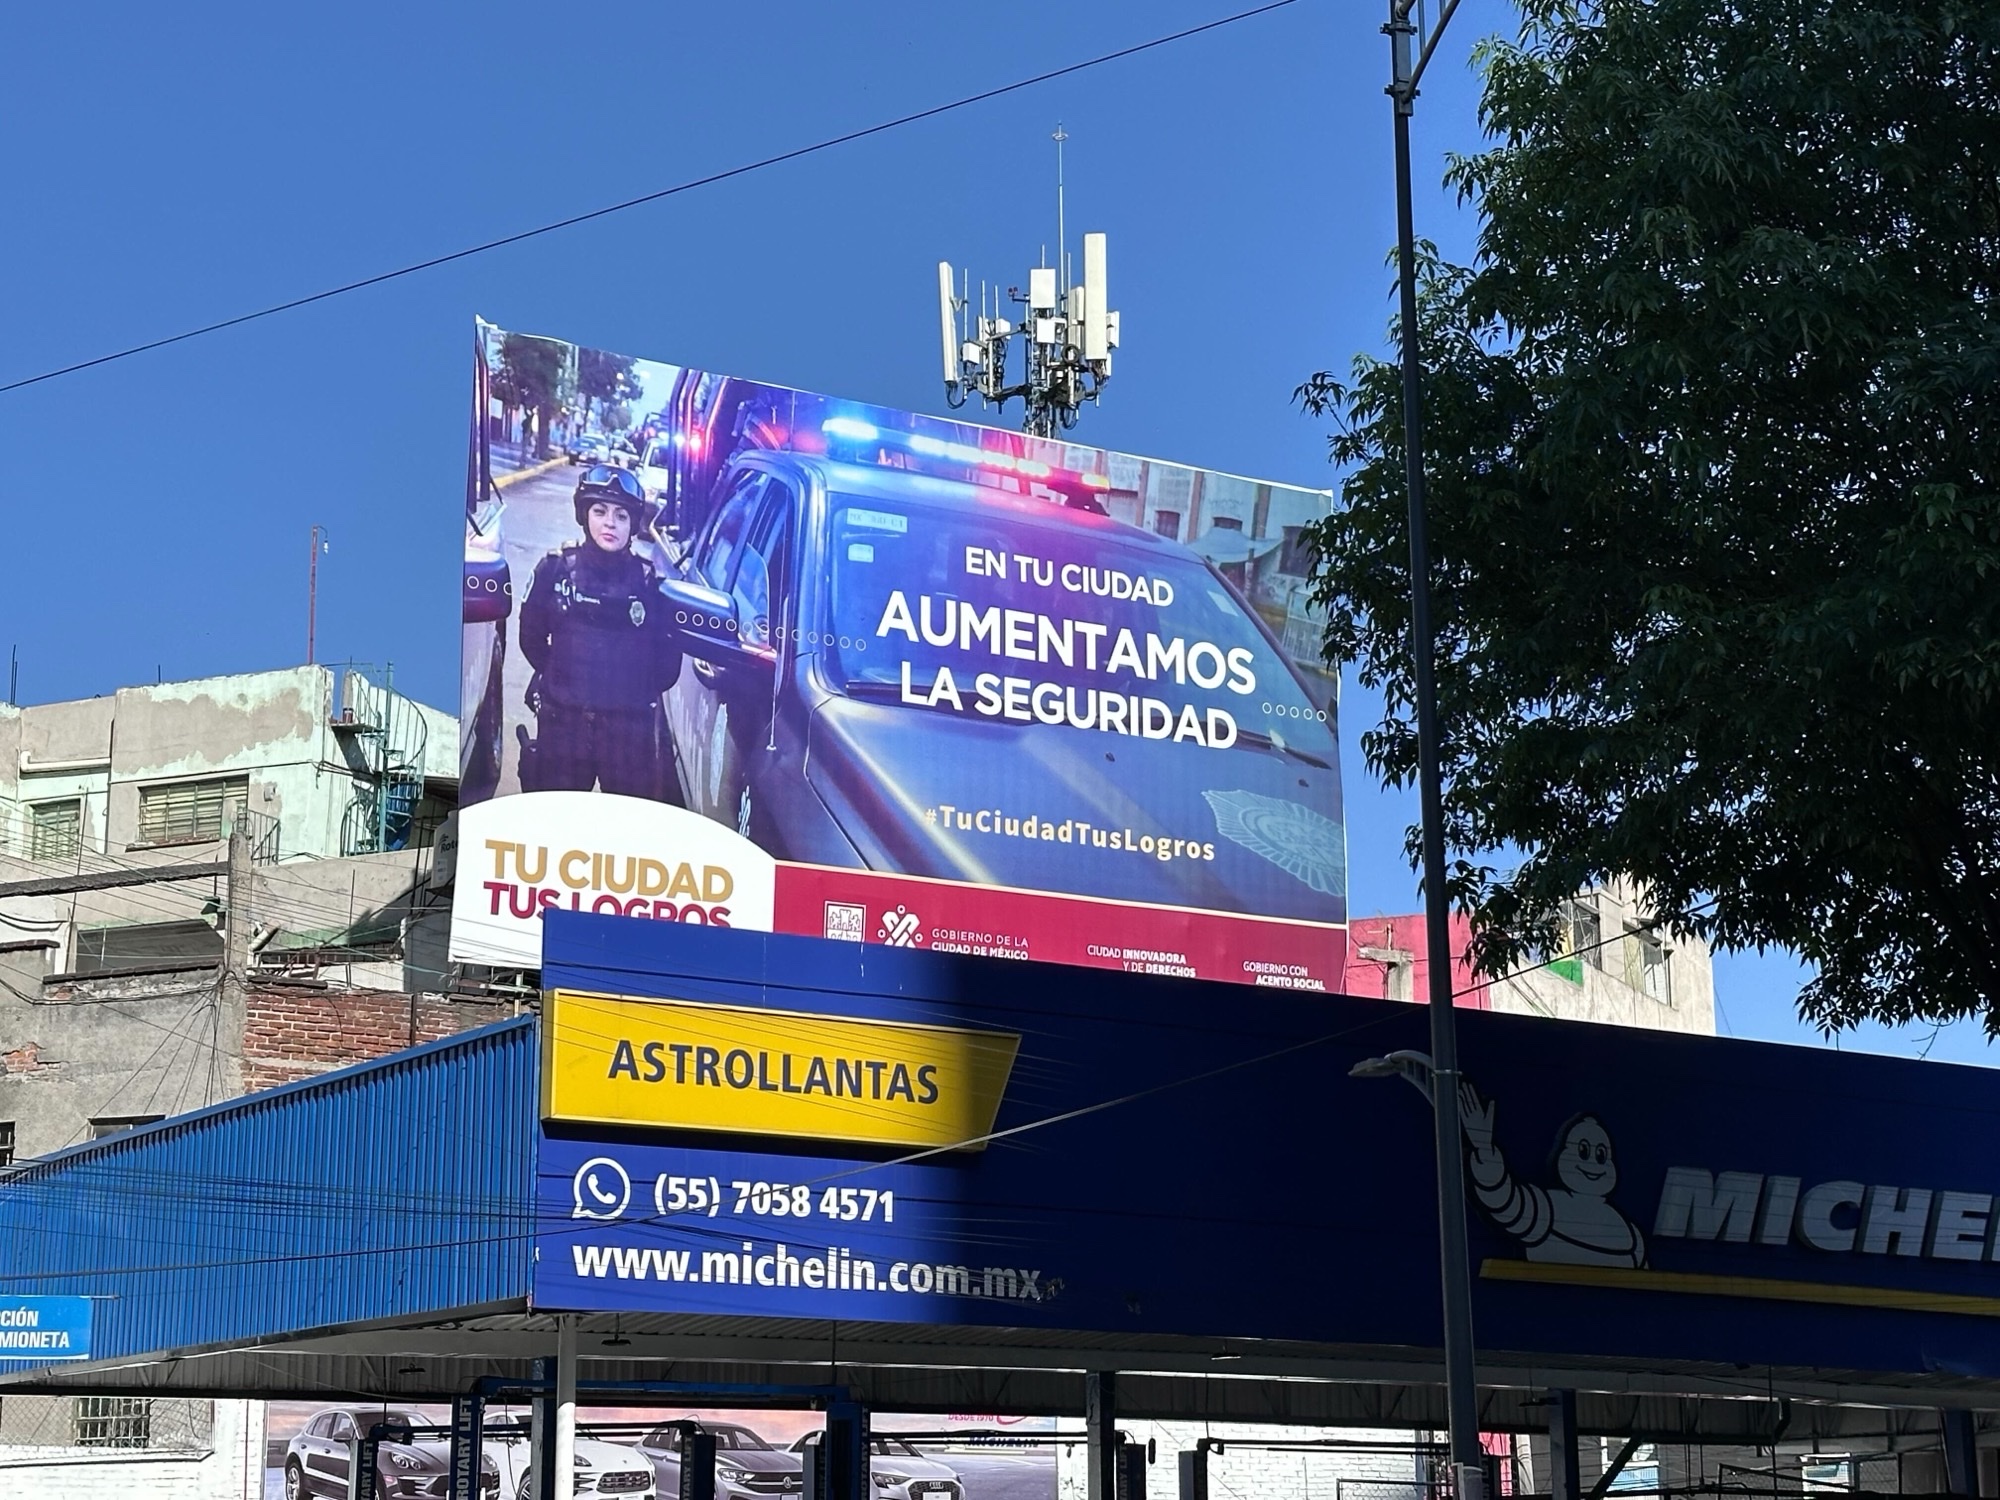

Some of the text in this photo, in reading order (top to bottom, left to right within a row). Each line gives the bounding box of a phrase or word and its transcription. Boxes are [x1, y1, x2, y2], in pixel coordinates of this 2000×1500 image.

[965, 546, 1175, 607] EN TU CIUDAD
[875, 590, 1257, 695] AUMENTAMOS
[901, 661, 1238, 750] LA SEGURIDAD
[924, 805, 1216, 862] #TuCiudadTusLogros
[485, 839, 549, 884] TU
[558, 850, 734, 903] CIUDAD
[483, 881, 561, 921] TUS
[931, 928, 1029, 948] GOBIERNO DE LA
[931, 941, 1029, 960] CIUDAD DE MÉXICO
[1086, 945, 1187, 965] CIUDAD INNOVADORA
[1123, 961, 1196, 978] Y DE DERECHOS
[1243, 961, 1308, 976] GOBIERNO CON
[1256, 975, 1326, 991] ACENTO SOCIAL
[607, 1039, 940, 1105] ASTROLLANTAS
[654, 1173, 894, 1223] (55) 7058 4571
[1652, 1165, 2000, 1262] MICHE
[572, 1242, 1041, 1300] www.michelin.com.mx
[0, 1306, 39, 1327] CIÓN
[455, 1397, 472, 1500] ROTARY LIFT
